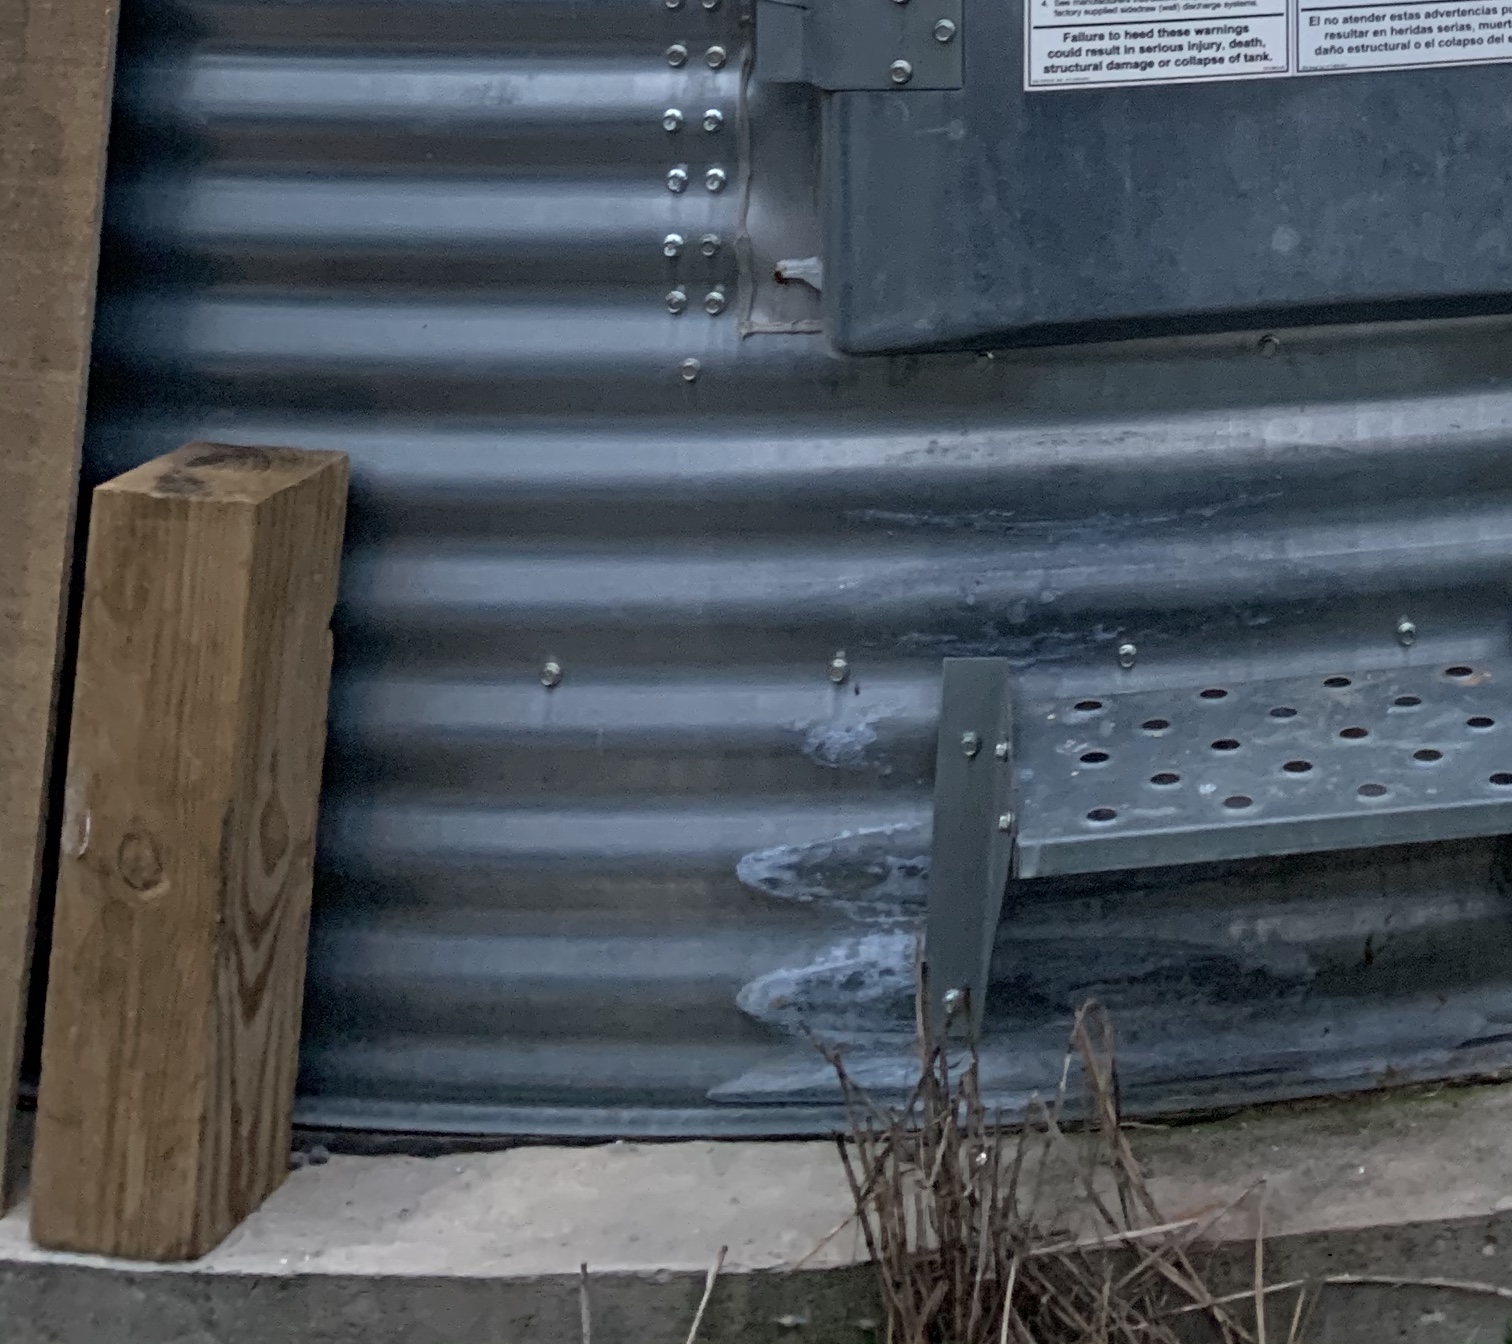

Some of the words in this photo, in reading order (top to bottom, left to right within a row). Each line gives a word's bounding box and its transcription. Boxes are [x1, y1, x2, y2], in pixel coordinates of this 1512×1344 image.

[1309, 16, 1320, 26] El
[1324, 16, 1339, 26] no
[1342, 14, 1386, 25] atender
[1389, 11, 1421, 20] estas
[1424, 6, 1498, 19] advertencias
[1063, 30, 1105, 43] Failure
[1108, 29, 1120, 41] to
[1124, 28, 1154, 40] heed
[1158, 26, 1190, 39] these
[1194, 23, 1249, 37] warnings
[1324, 29, 1369, 40] resultar
[1373, 28, 1387, 38] en
[1390, 26, 1434, 37] heridas
[1437, 22, 1475, 34] serias,
[1047, 46, 1082, 59] could
[1085, 44, 1121, 57] result
[1124, 43, 1135, 54] in
[1139, 41, 1184, 54] serious
[1187, 39, 1226, 53] injury,
[1229, 36, 1266, 49] death,
[1314, 43, 1344, 56] daño
[1347, 39, 1411, 54] estructural
[1414, 40, 1421, 49] o
[1424, 38, 1435, 48] el
[1438, 35, 1484, 48] colapso
[1487, 33, 1505, 44] del
[1043, 60, 1103, 74] structural
[1106, 58, 1154, 72] damage
[1158, 57, 1172, 67] or
[1174, 54, 1225, 67] collapse
[1229, 52, 1241, 63] of
[1244, 50, 1273, 63] tank.
